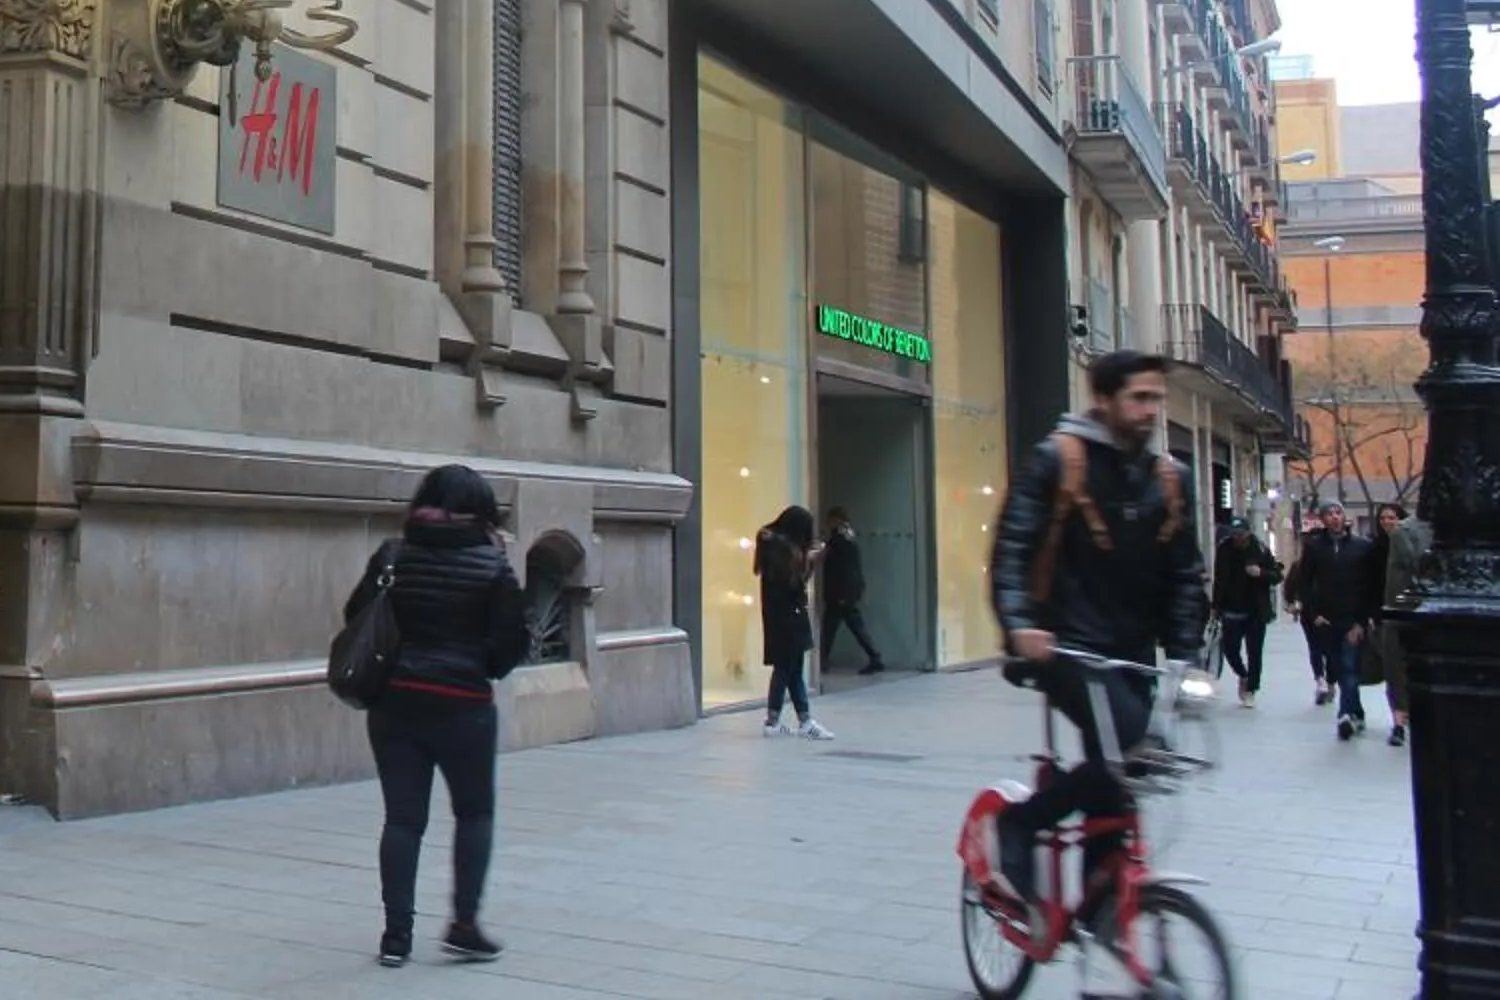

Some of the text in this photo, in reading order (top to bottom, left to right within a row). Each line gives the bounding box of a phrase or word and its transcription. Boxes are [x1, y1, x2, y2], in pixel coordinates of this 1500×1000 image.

[238, 71, 319, 195] H&M
[819, 304, 851, 338] UNITED
[883, 326, 893, 351] OF
